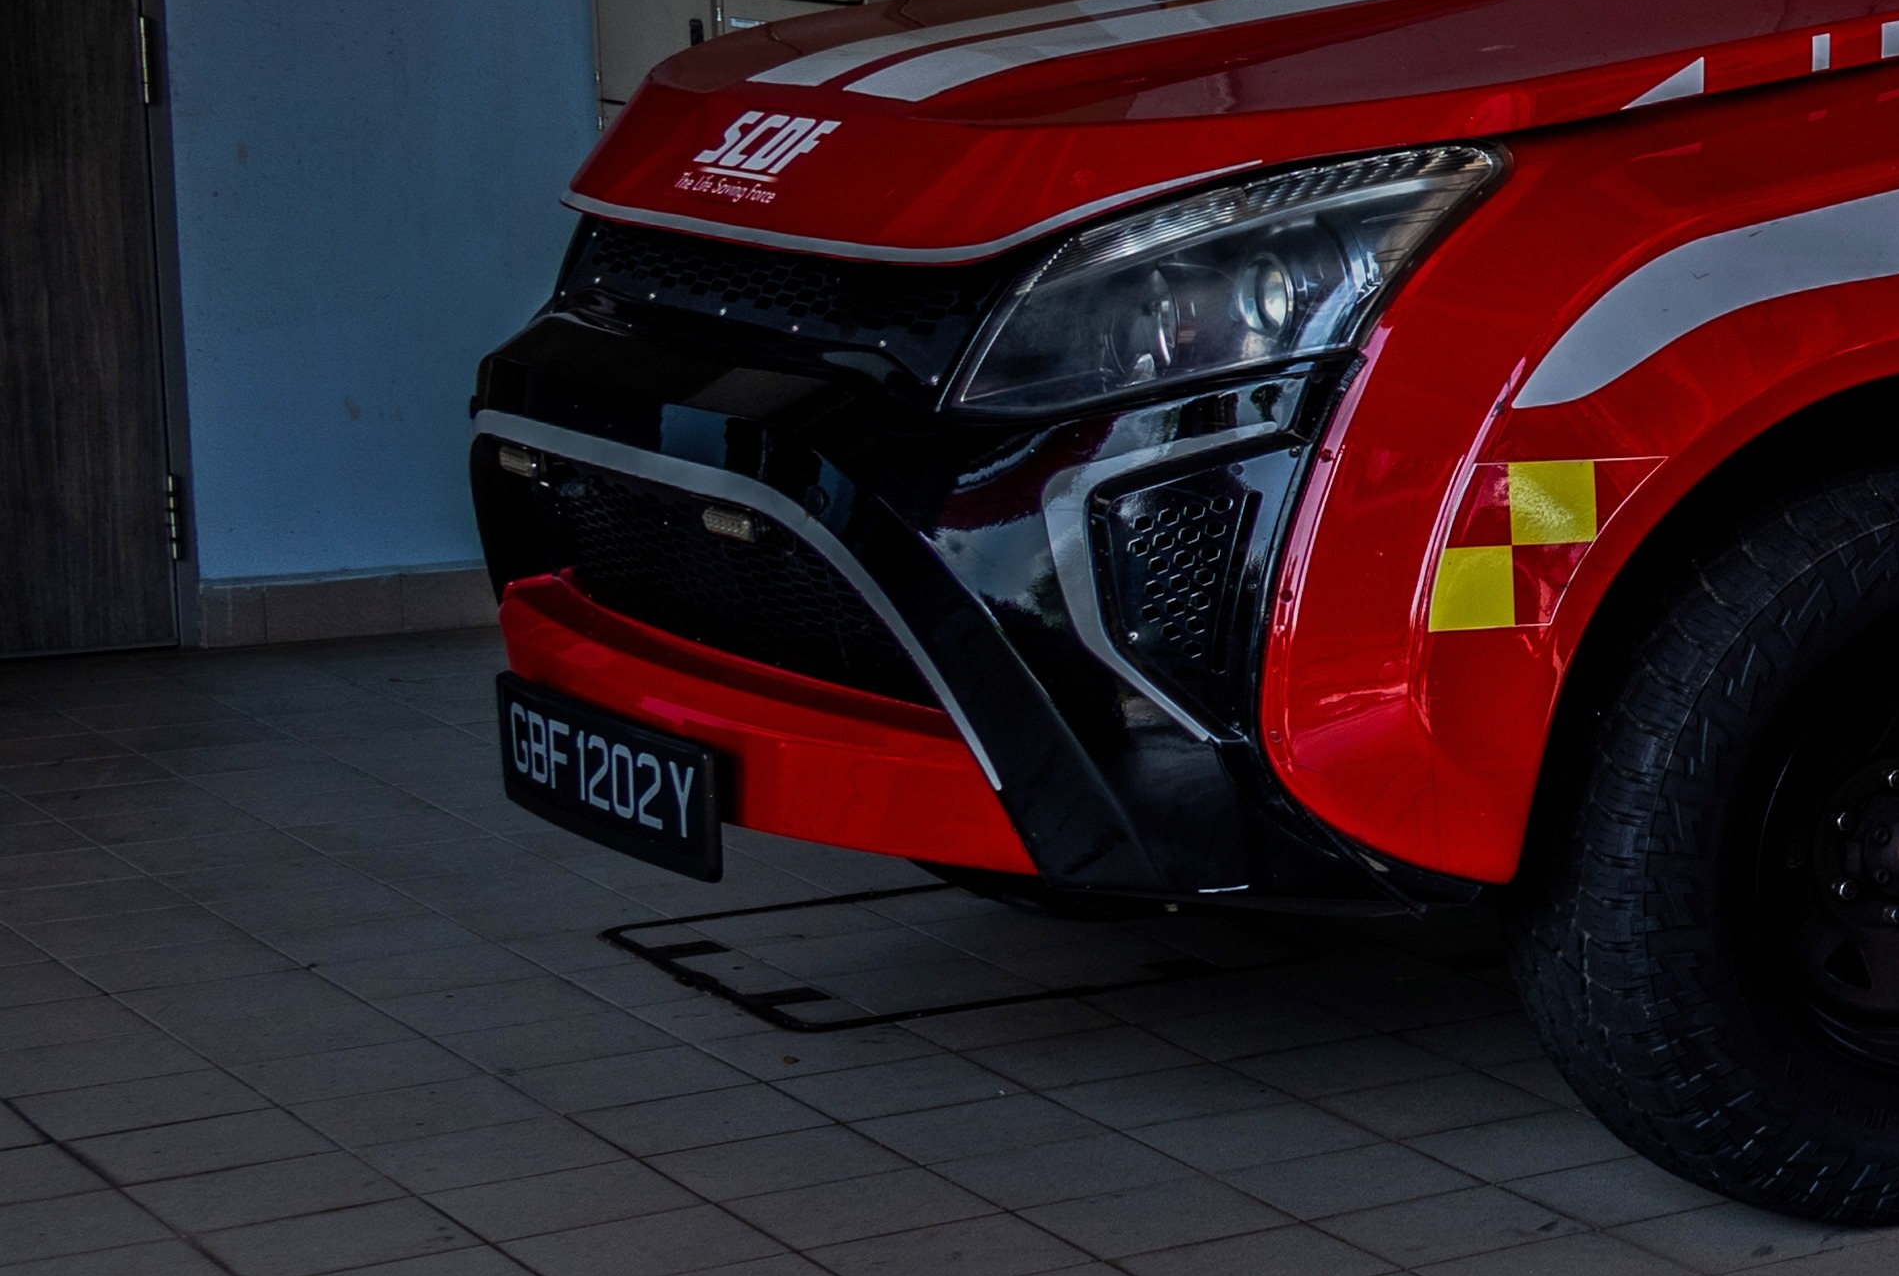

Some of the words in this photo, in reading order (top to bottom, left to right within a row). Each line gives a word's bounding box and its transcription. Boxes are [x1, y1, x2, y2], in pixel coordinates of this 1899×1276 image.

[692, 110, 842, 174] SCDF
[674, 171, 695, 190] The
[692, 175, 713, 192] Life
[711, 178, 748, 203] Saving
[745, 183, 777, 204] Force
